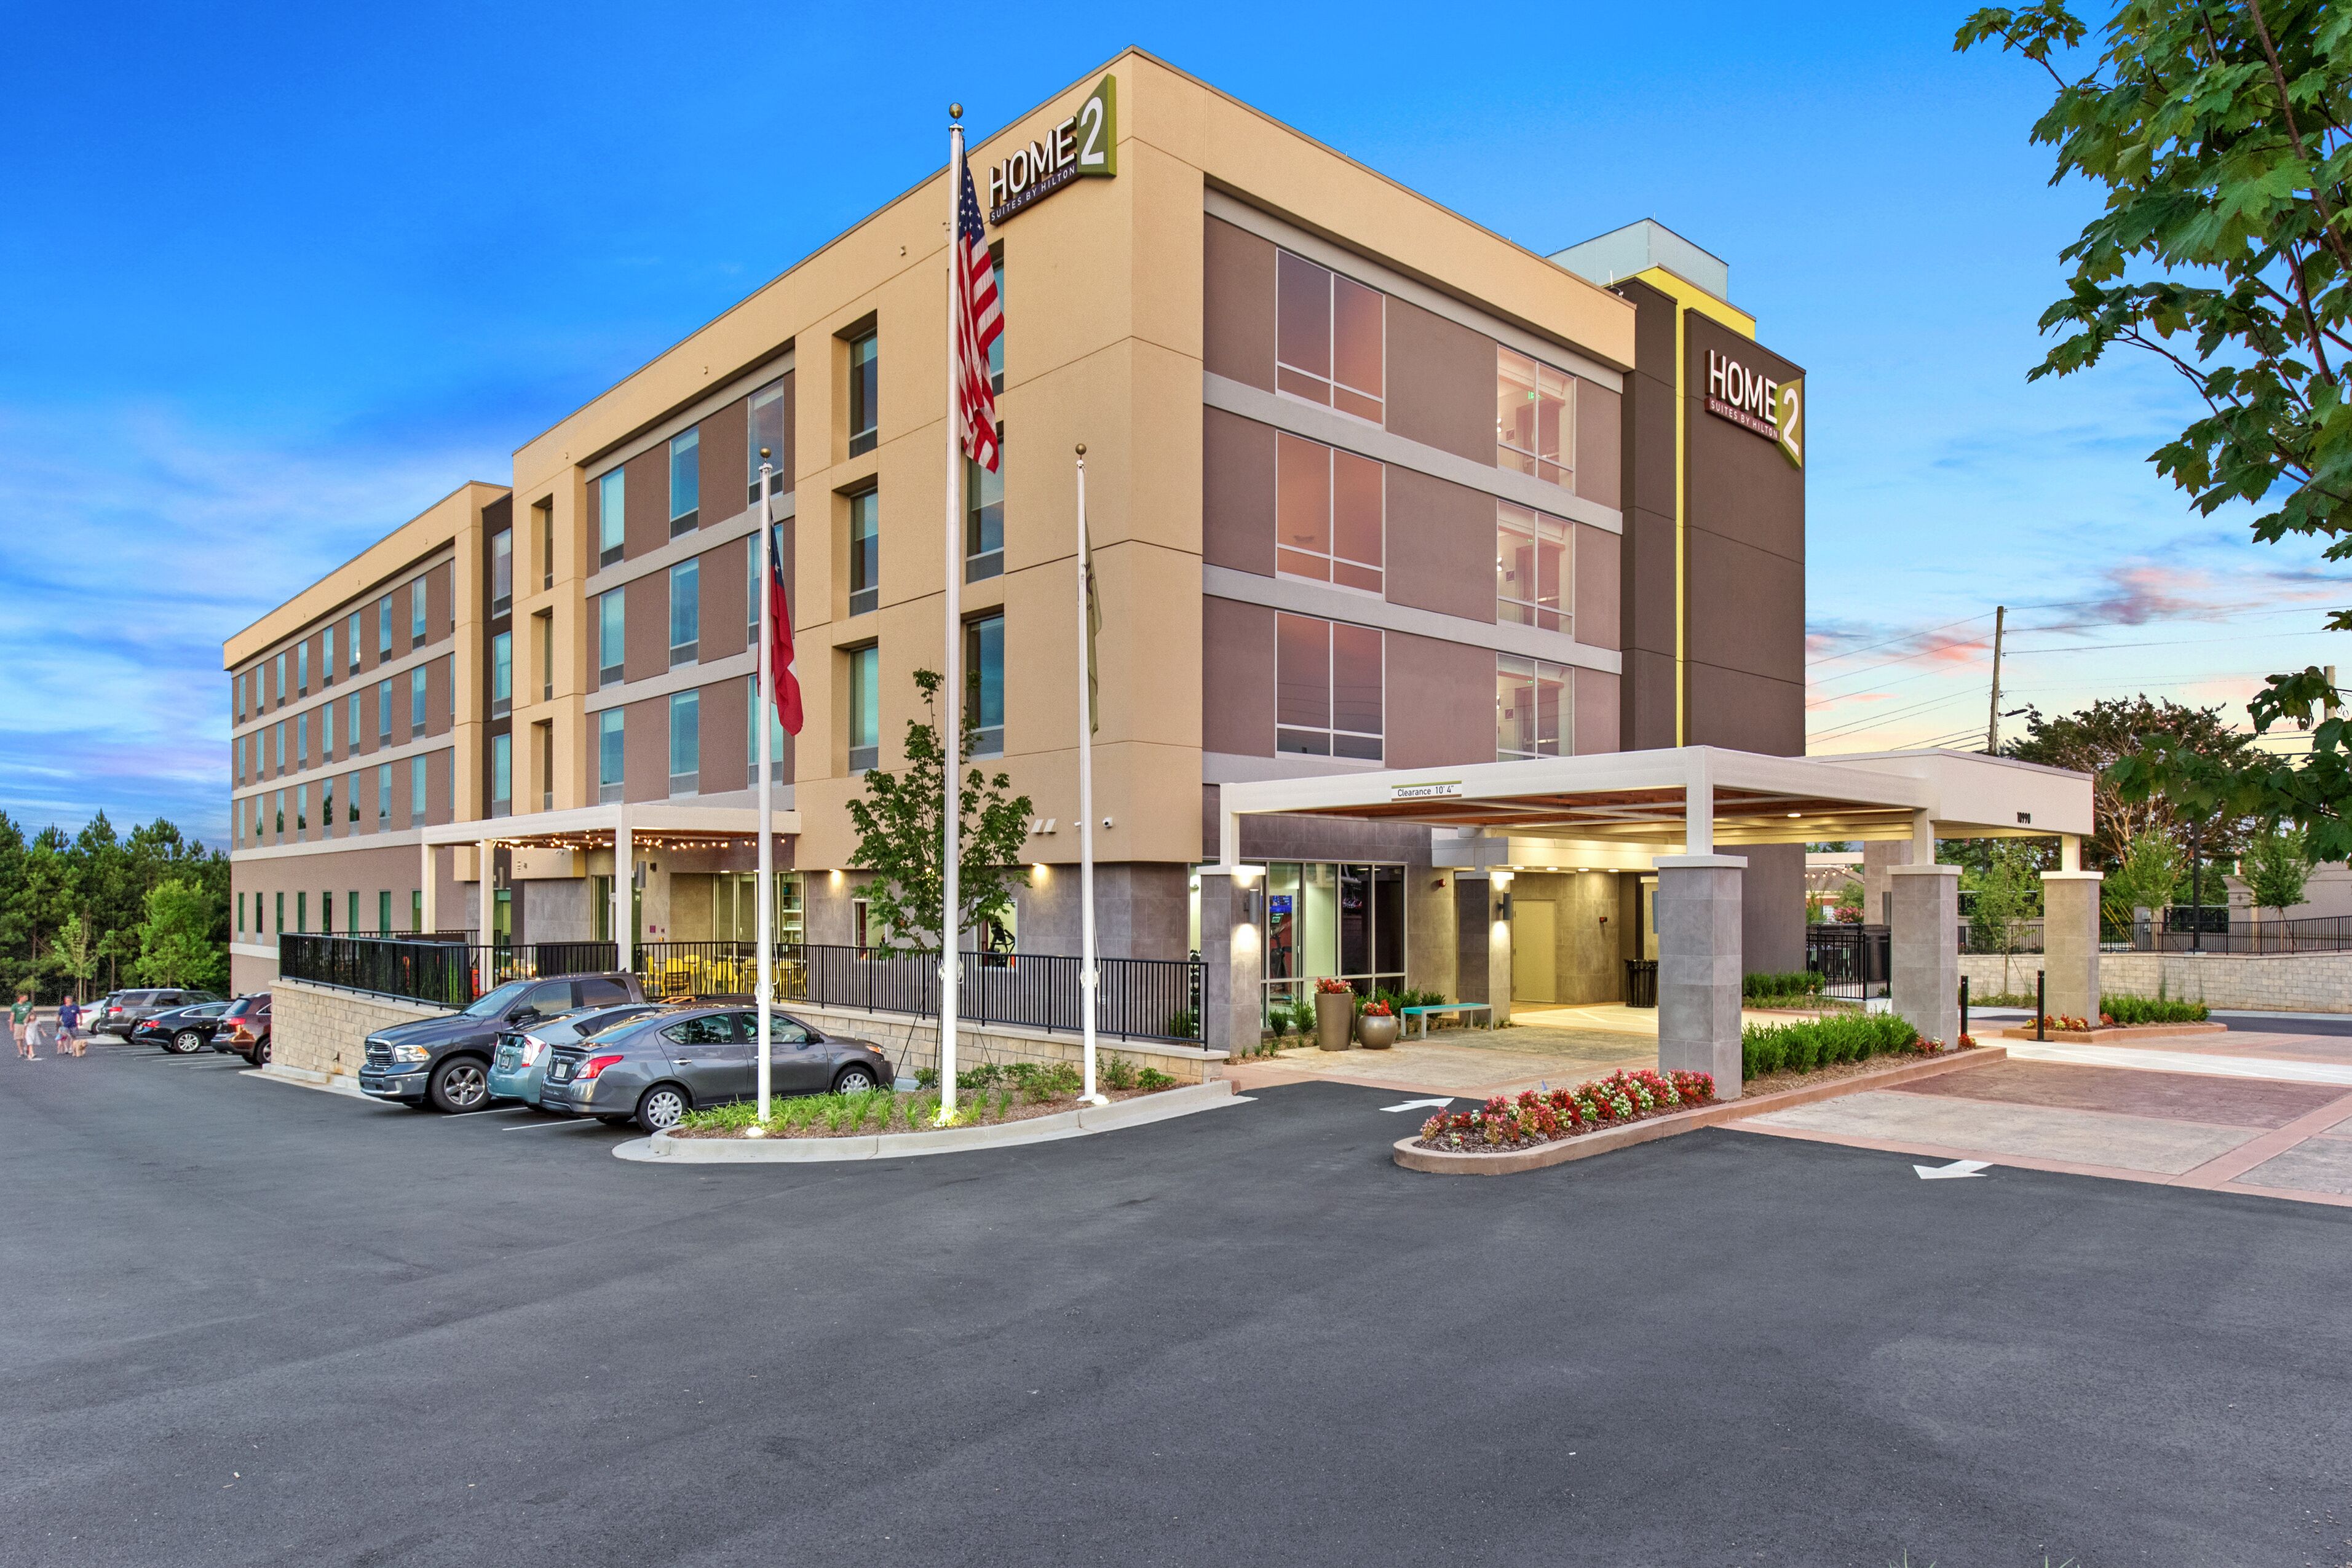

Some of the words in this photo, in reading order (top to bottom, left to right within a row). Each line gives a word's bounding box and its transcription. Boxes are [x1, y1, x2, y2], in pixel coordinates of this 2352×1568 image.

[989, 116, 1075, 208] HOME
[1080, 97, 1104, 165] 2
[991, 197, 1021, 221] SUITES
[1026, 189, 1037, 200] BY
[1041, 165, 1075, 192] HILTON
[1710, 349, 1778, 424] HOME
[1783, 388, 1799, 456] 2
[1711, 400, 1737, 420] SUITES
[1741, 414, 1750, 425] BY
[1752, 420, 1778, 438] HILTON
[1398, 788, 1431, 797] Clearance
[2017, 812, 2030, 824] 10990
